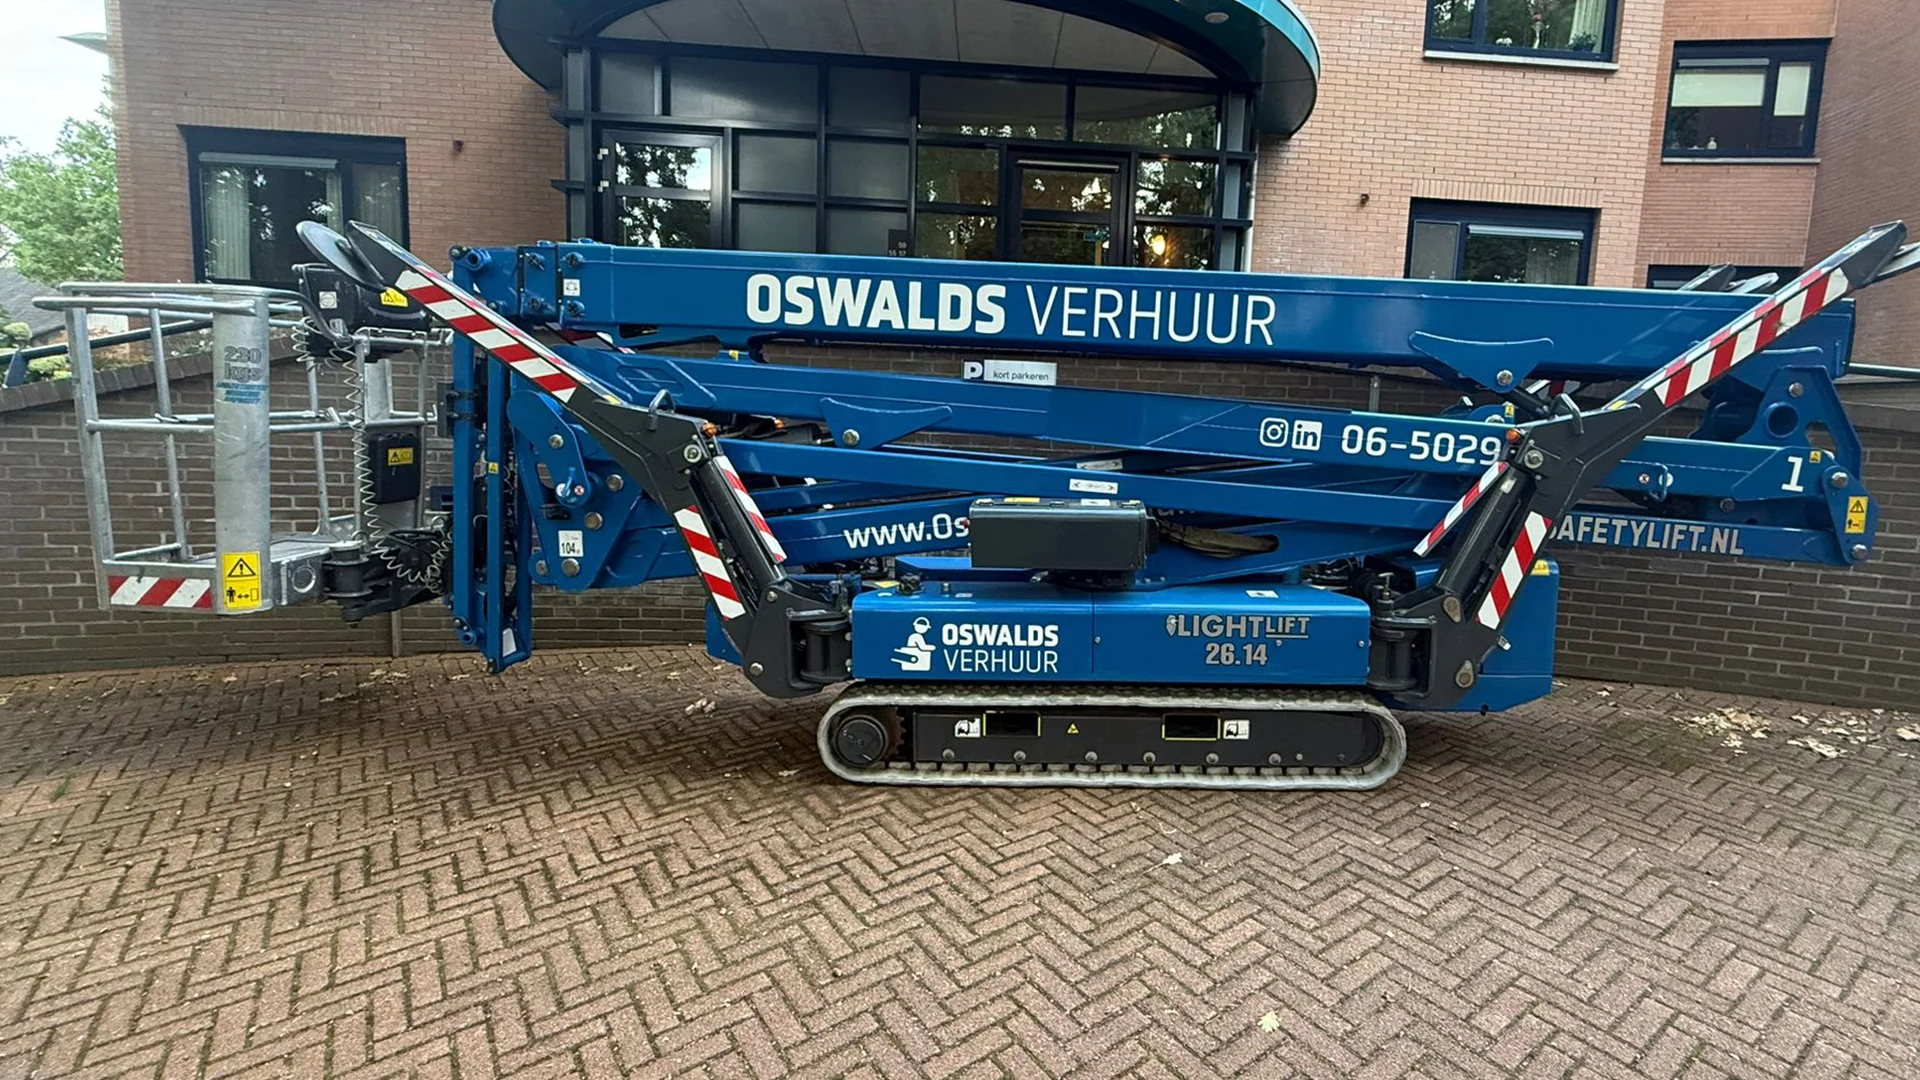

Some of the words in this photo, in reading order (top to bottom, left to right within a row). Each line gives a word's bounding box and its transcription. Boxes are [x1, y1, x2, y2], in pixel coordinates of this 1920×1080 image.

[746, 273, 1006, 334] OSWALDS
[1026, 284, 1276, 346] VERHUUR
[224, 345, 262, 364] 230
[964, 362, 983, 379] P
[993, 370, 1010, 379] kort
[1011, 371, 1049, 381] parkeren
[1341, 424, 1501, 467] 06-5029
[1781, 456, 1804, 492] 1
[942, 623, 1059, 647] OSWALDS
[943, 649, 1058, 673] VERHUUR
[1205, 643, 1268, 665] 26.14
